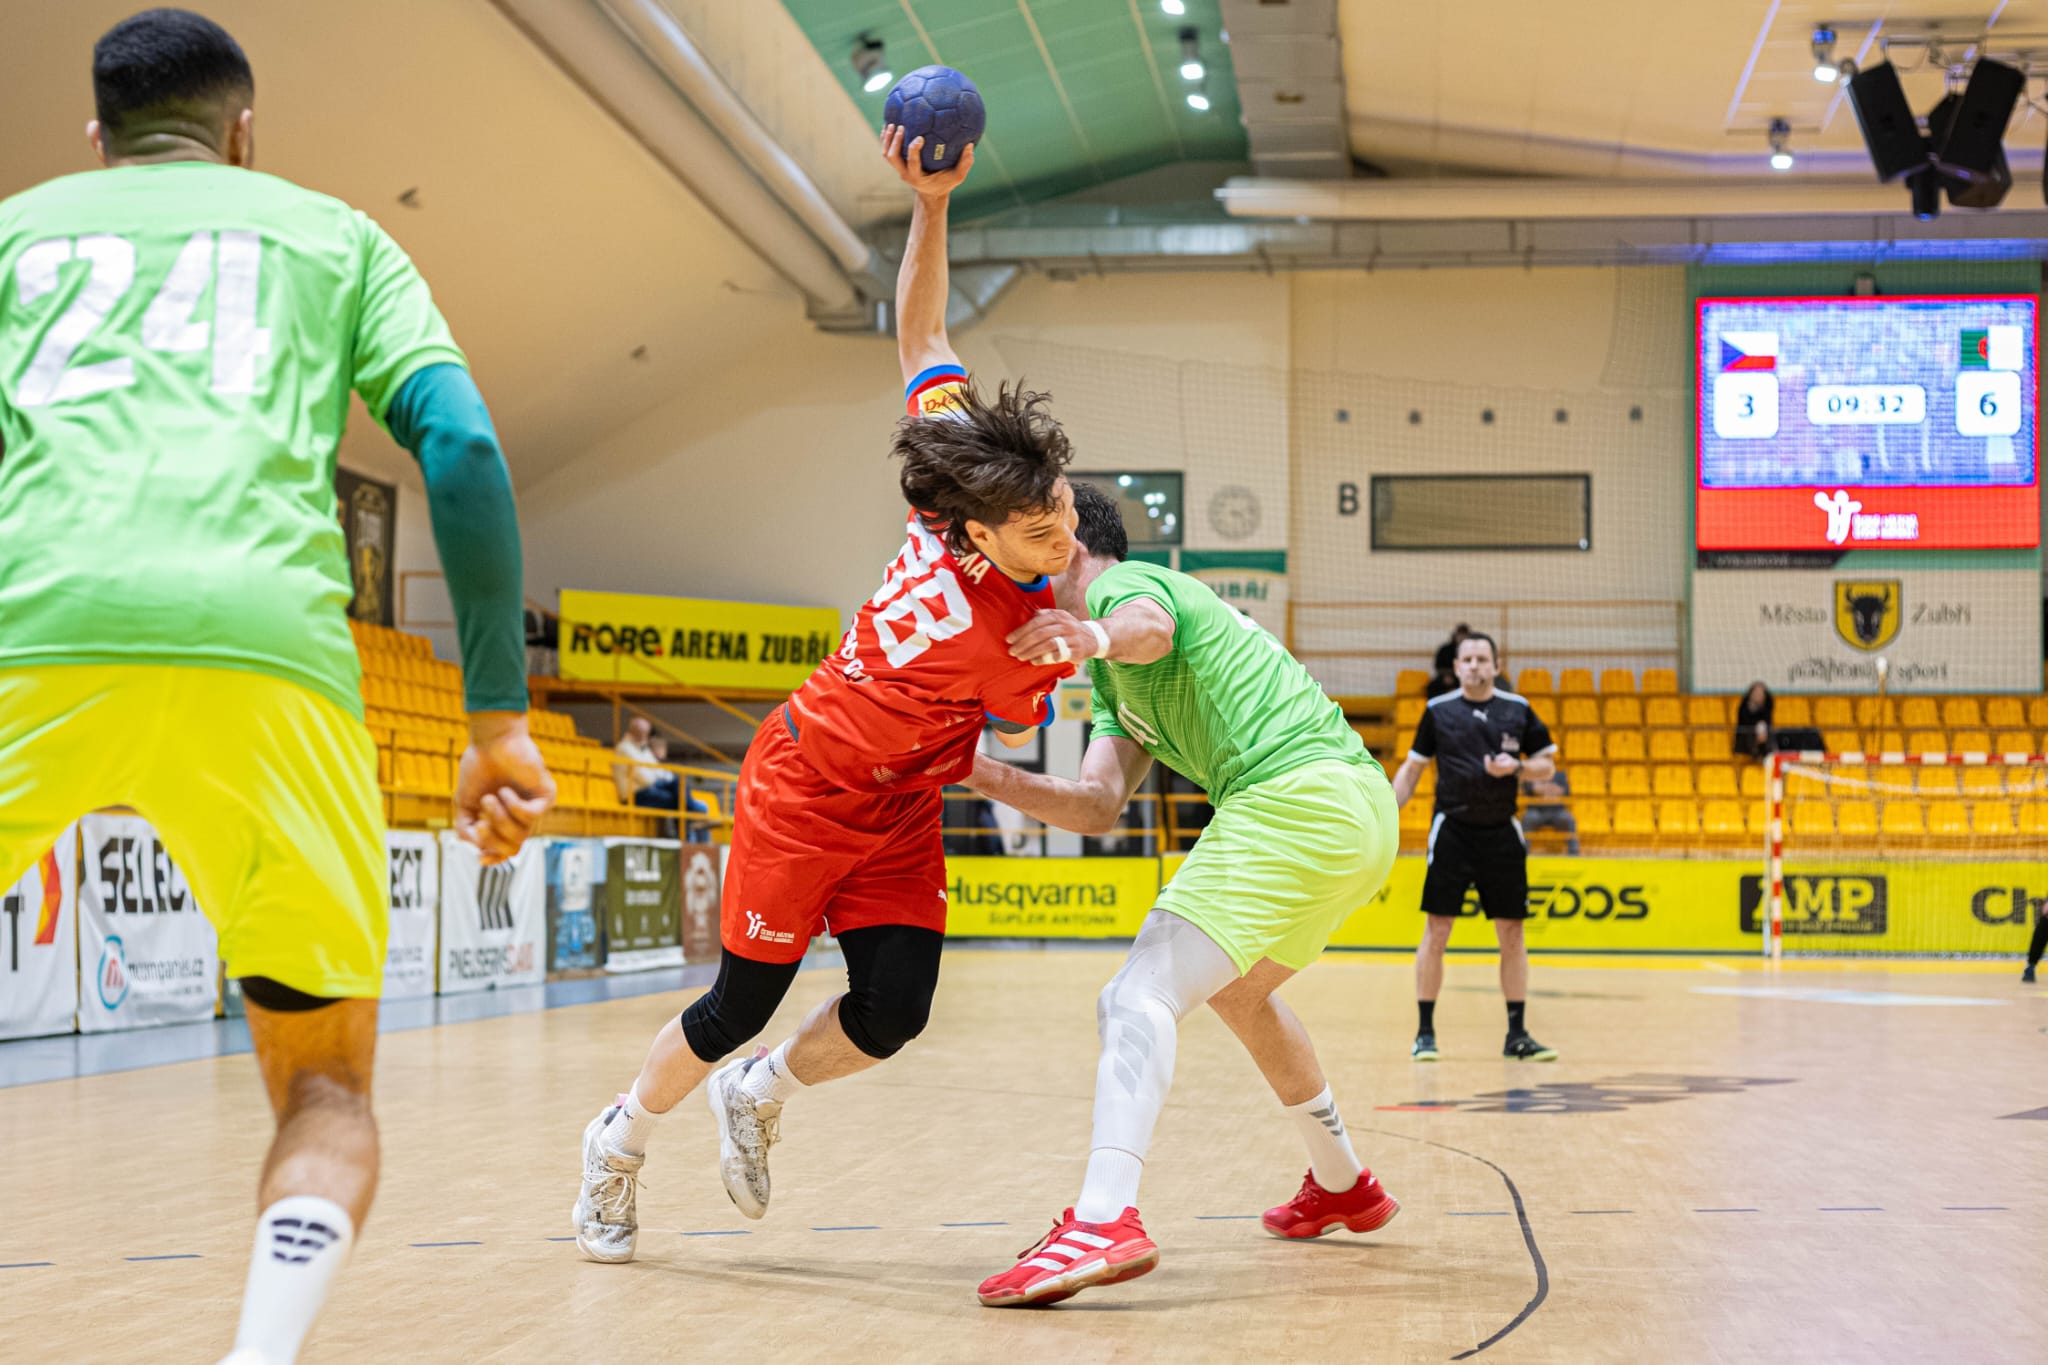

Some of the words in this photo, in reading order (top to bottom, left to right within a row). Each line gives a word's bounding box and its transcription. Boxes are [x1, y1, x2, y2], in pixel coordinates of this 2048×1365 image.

[15, 230, 271, 407] 24
[1737, 394, 1755, 418] 3
[1827, 394, 1904, 414] 09:32
[1979, 393, 1998, 417] 6
[1338, 484, 1359, 515] B
[670, 627, 749, 662] ARENA
[759, 629, 830, 665] ZUBŘÍ
[946, 876, 1116, 909] Husqvarna
[1751, 877, 1875, 921] AMP
